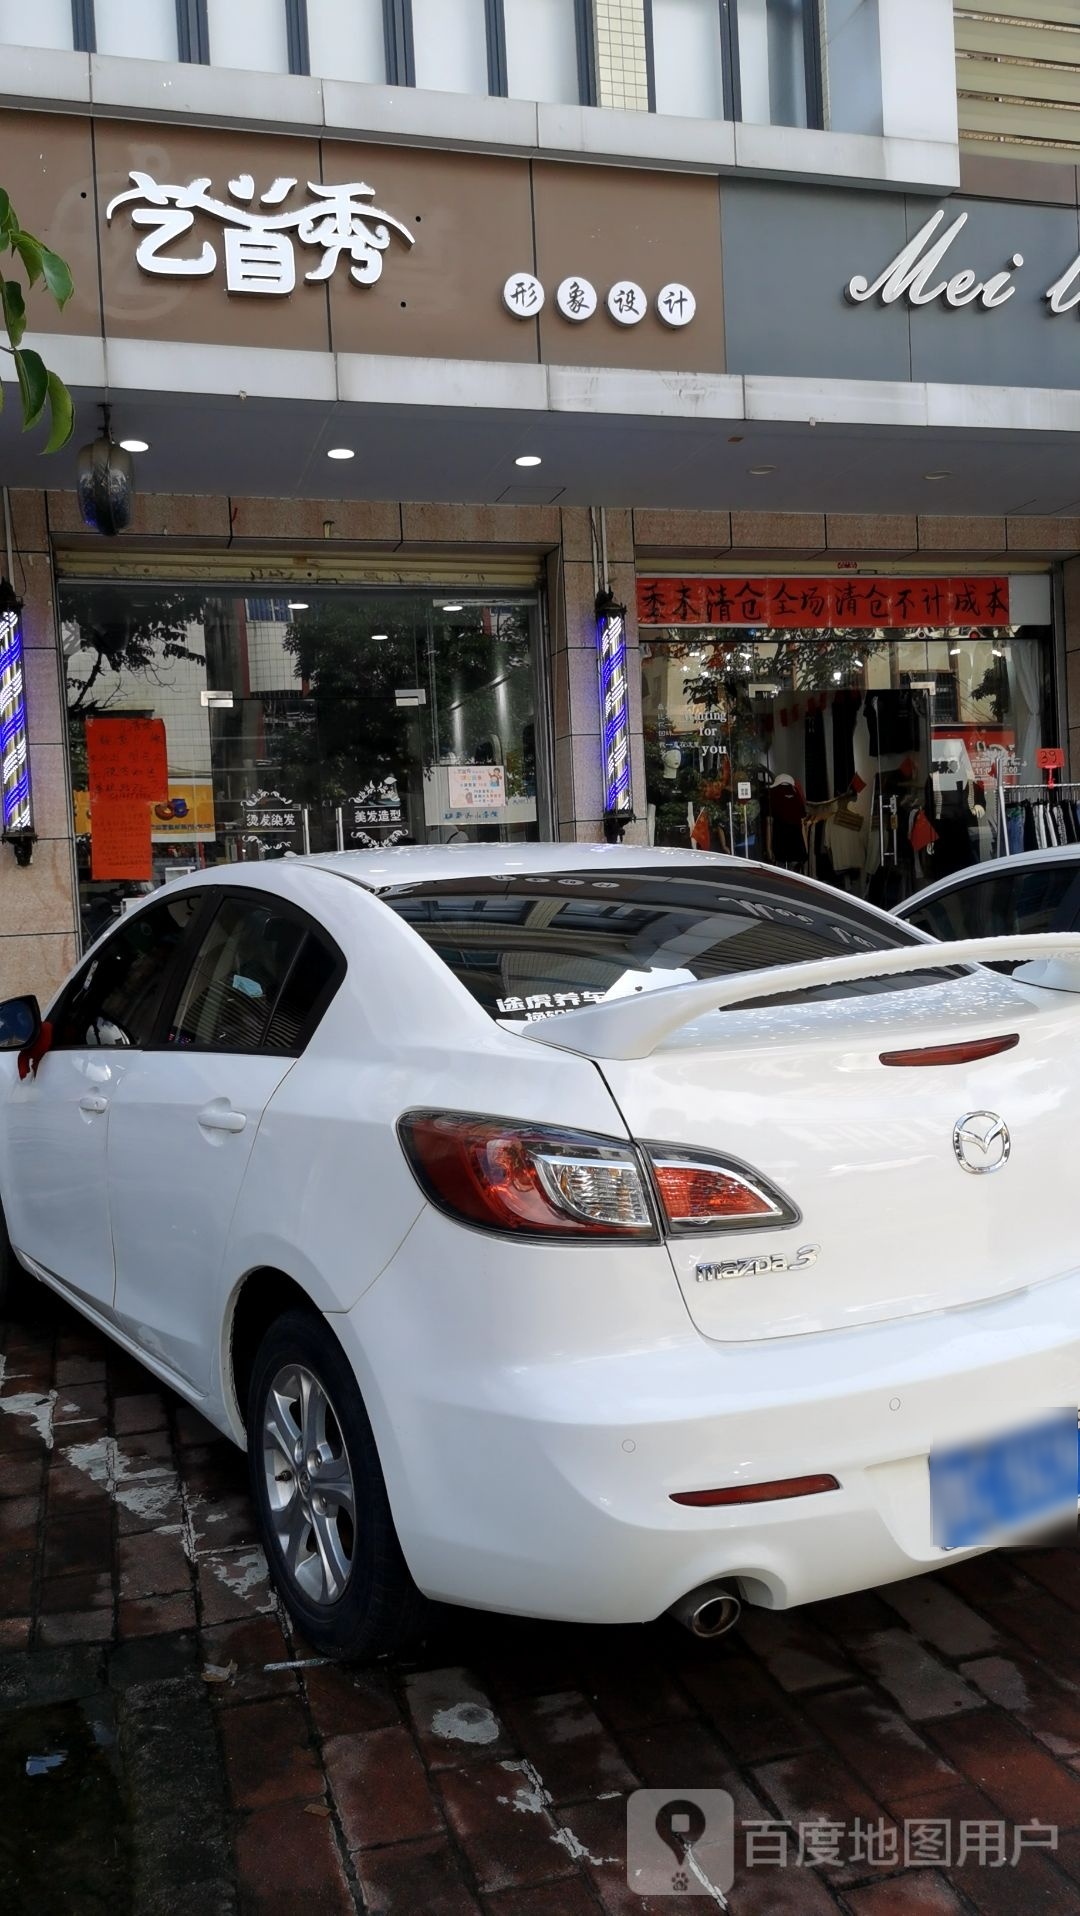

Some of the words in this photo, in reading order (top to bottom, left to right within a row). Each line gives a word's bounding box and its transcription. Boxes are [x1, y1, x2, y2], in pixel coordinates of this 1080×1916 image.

[106, 171, 416, 294] 艺首秀
[849, 209, 1024, 308] Mei
[509, 281, 689, 320] 形象设计
[699, 726, 718, 736] for
[701, 745, 727, 756] you
[246, 813, 296, 827] 烫发染发
[354, 809, 401, 823] 美发造型
[496, 991, 606, 1013] 途虎养车
